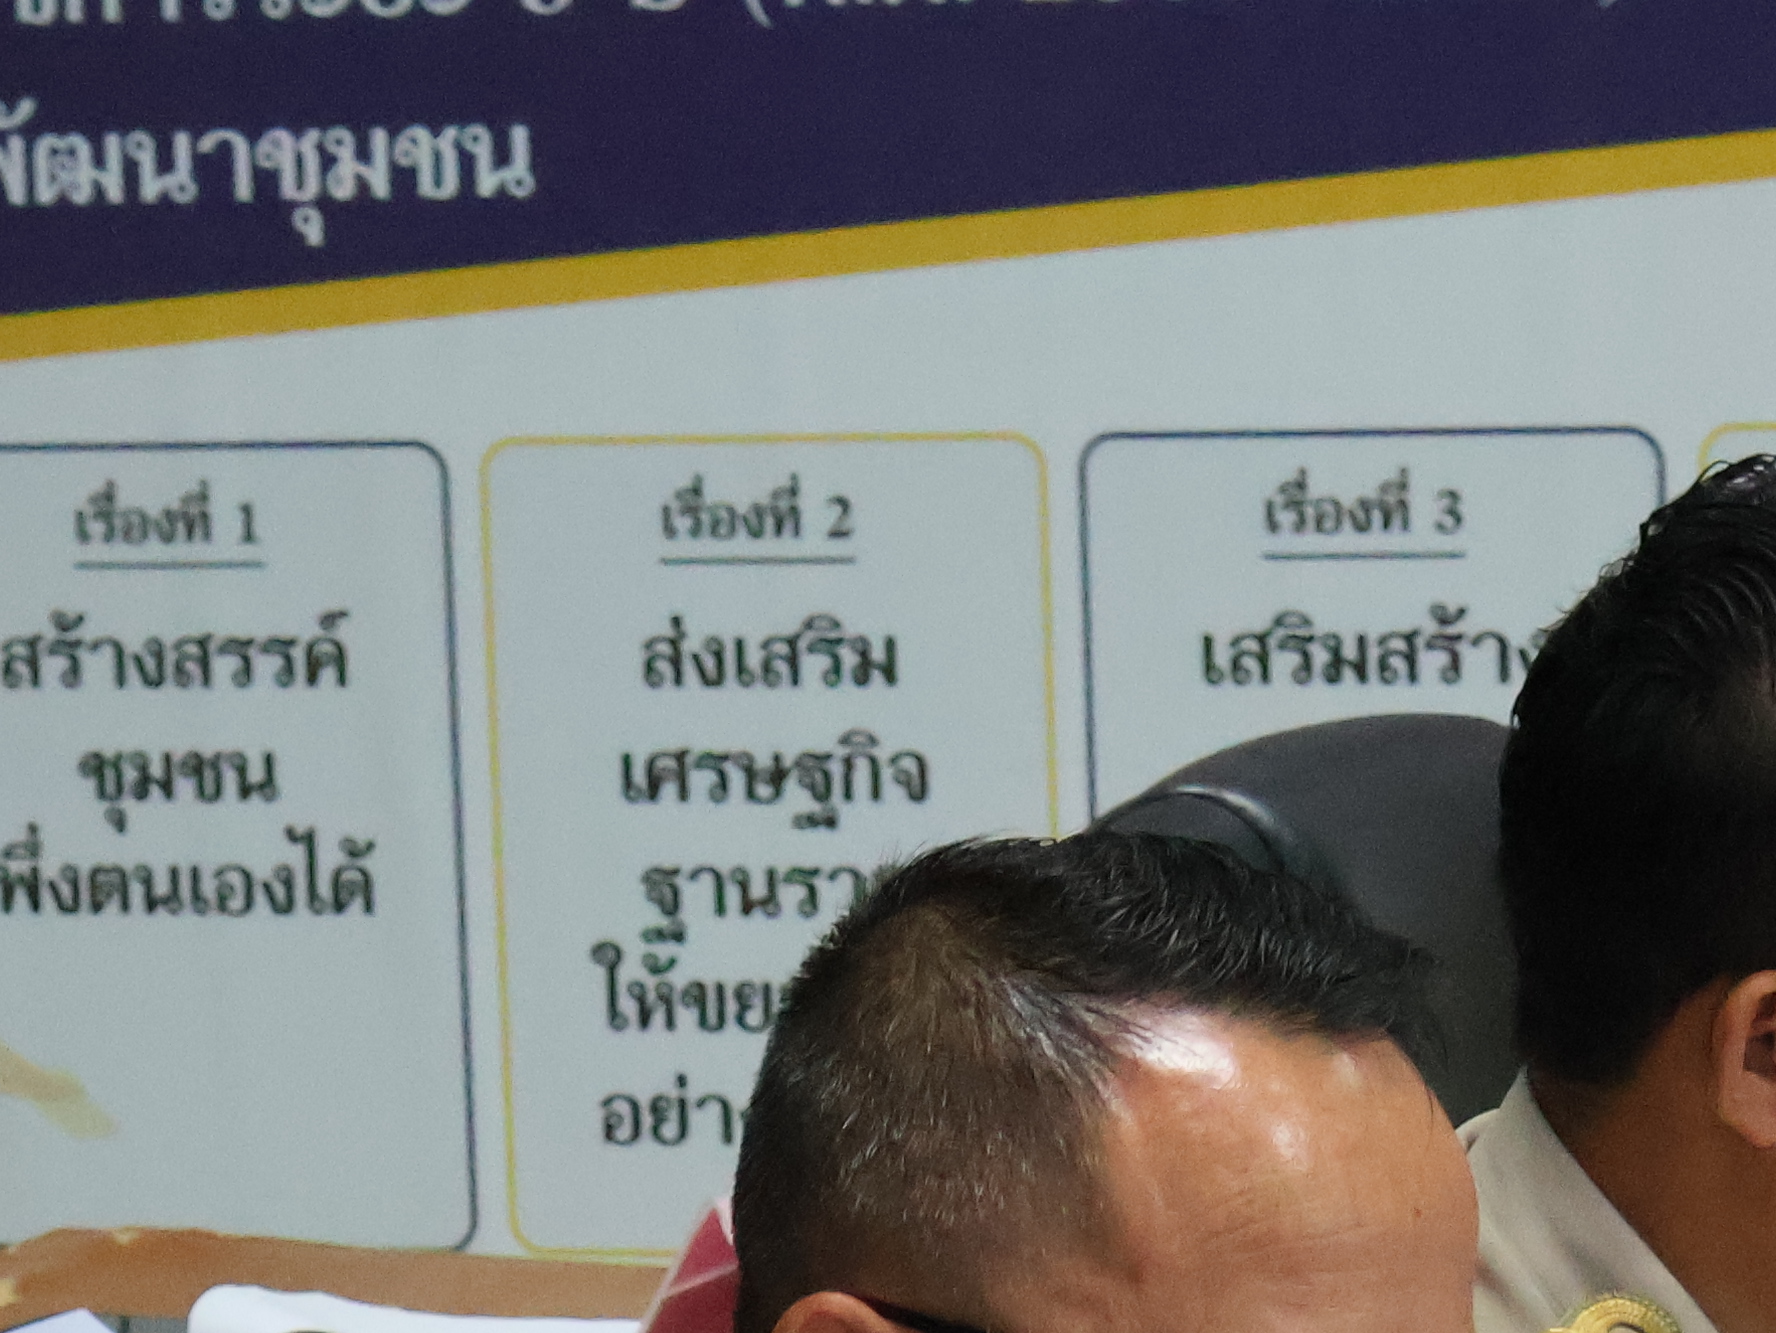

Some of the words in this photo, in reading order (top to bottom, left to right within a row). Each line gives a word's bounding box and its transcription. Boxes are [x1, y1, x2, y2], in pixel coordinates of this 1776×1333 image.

[74, 479, 213, 546] เรื่องที่
[238, 501, 260, 546] 1
[661, 473, 802, 541] เรื่องที่
[825, 494, 855, 541] 2
[1264, 467, 1411, 536] เรื่องที่
[1433, 487, 1465, 536] 3
[0, 609, 350, 690] สร้างสรรค์
[642, 614, 900, 690] ส่งเสริม
[79, 750, 280, 833] ชุมชน
[619, 730, 931, 831] เศรษฐกิจ
[642, 866, 869, 943] ฐานรา
[591, 940, 786, 1032] ให้ขย
[600, 1073, 746, 1146] อย่า
